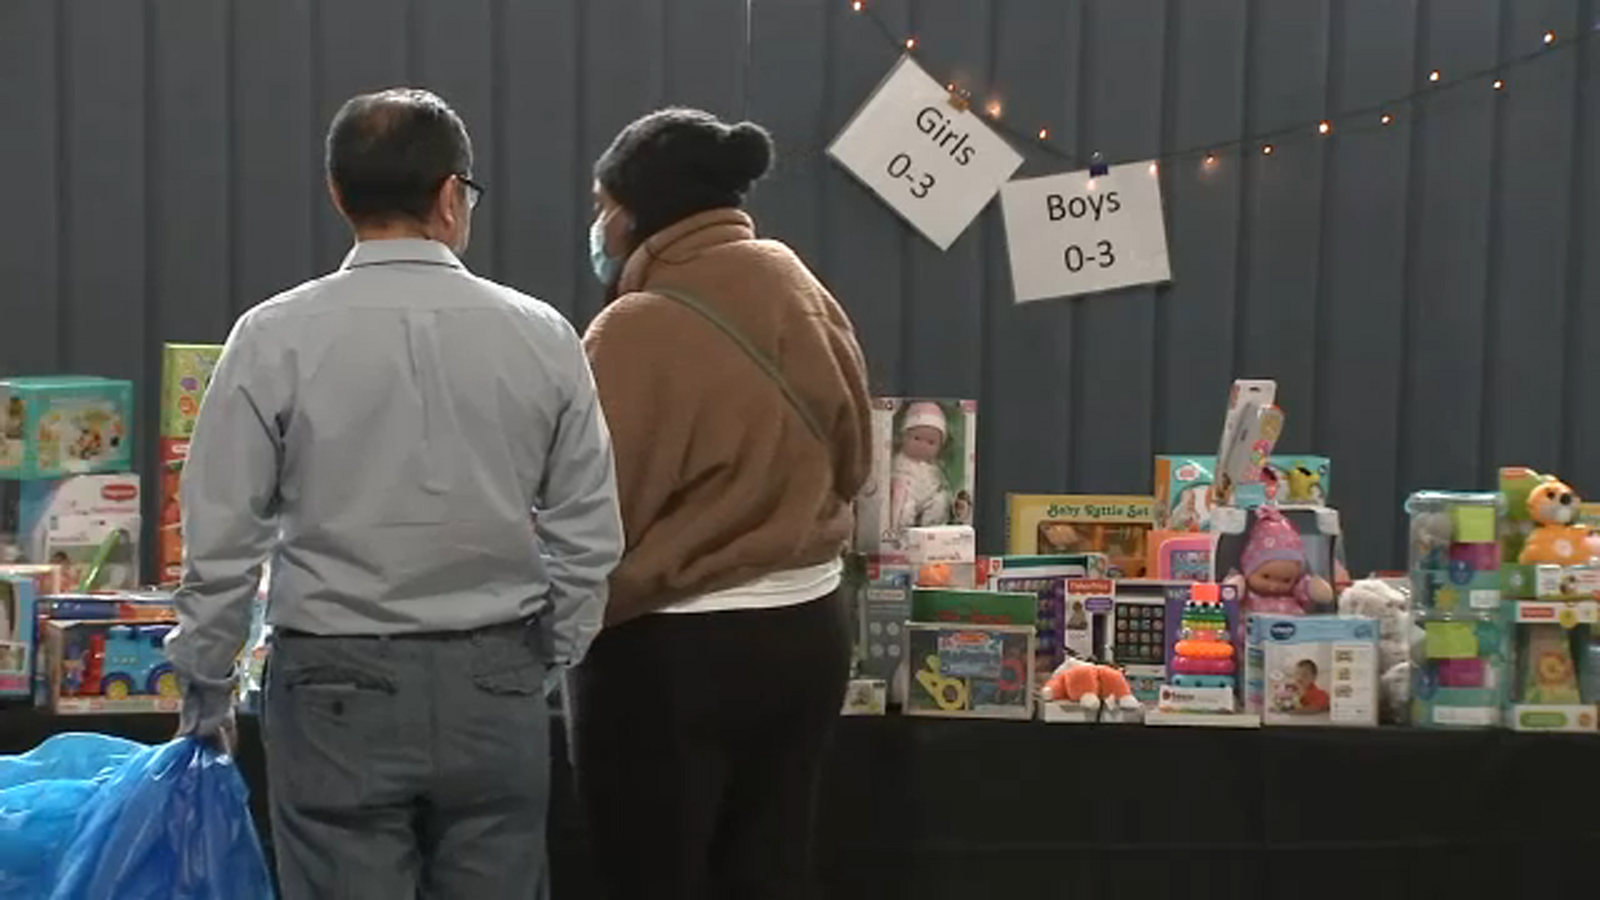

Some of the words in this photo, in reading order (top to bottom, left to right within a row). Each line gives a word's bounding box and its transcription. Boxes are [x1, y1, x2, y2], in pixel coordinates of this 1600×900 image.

[916, 106, 976, 166] Girls
[887, 153, 936, 199] 0-3
[1046, 191, 1121, 221] Boys
[1064, 239, 1116, 273] 0-3
[1047, 503, 1080, 518] Baby
